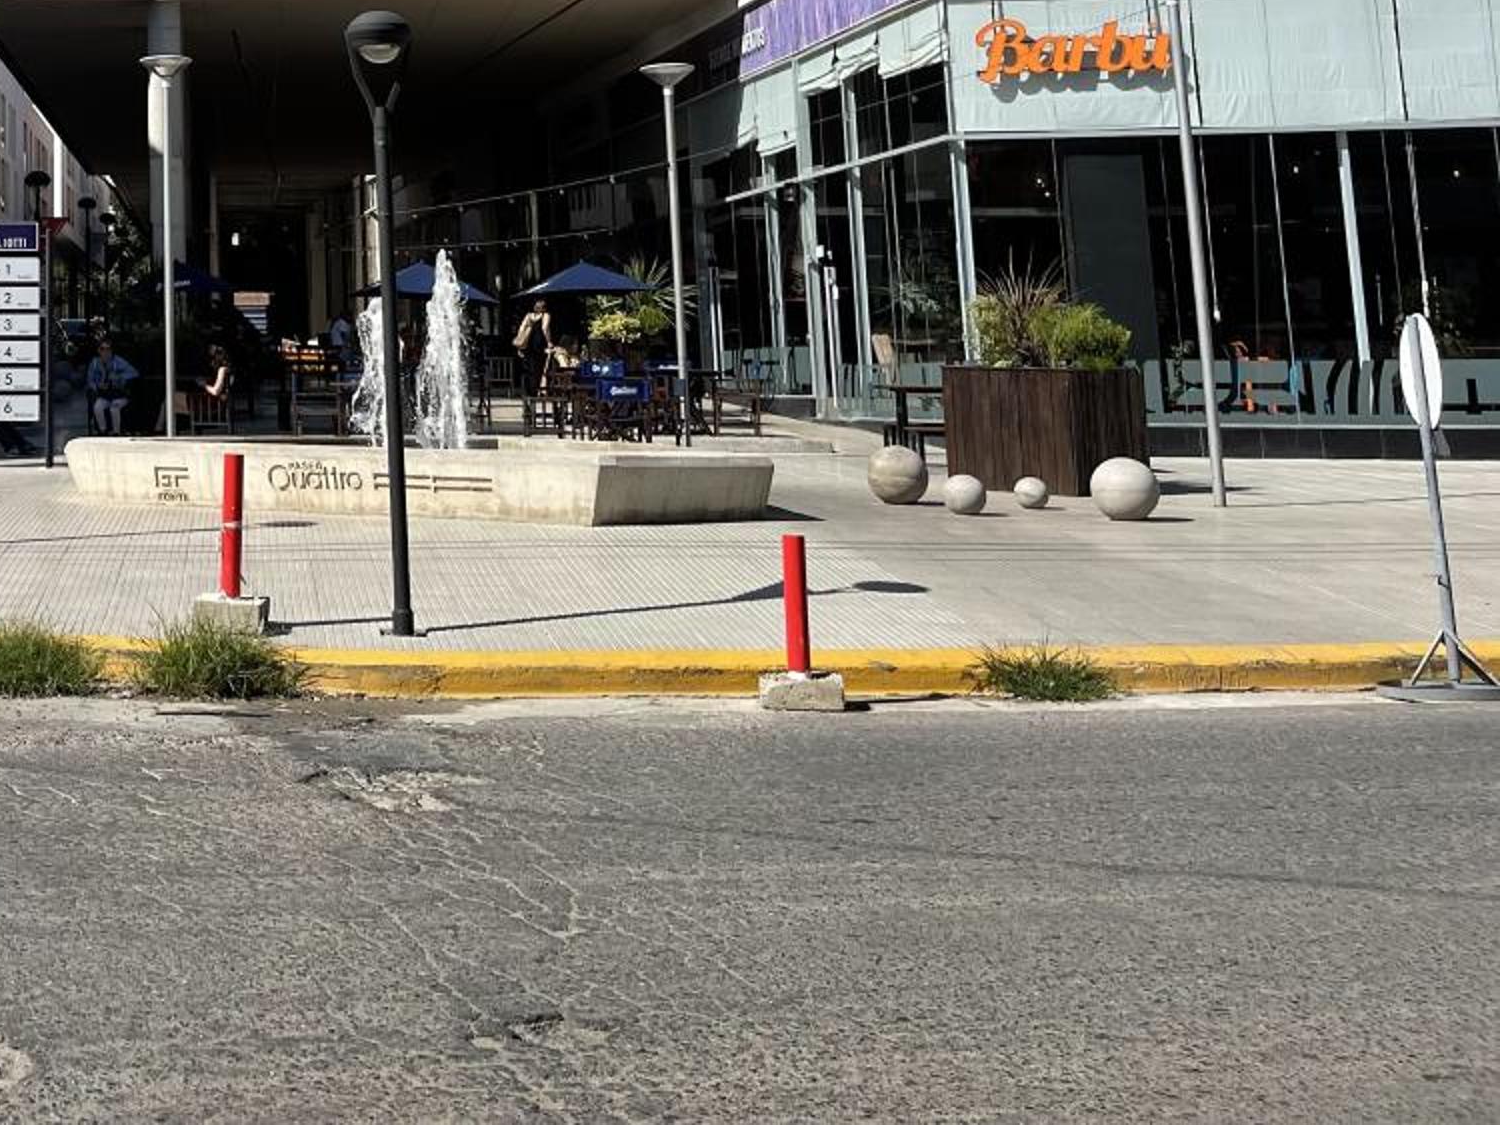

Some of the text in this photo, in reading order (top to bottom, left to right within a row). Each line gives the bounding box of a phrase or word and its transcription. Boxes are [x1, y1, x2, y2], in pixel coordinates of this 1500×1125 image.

[975, 18, 1172, 84] Barbu
[4, 292, 12, 304] 2
[4, 319, 12, 331] 3
[4, 346, 12, 358] 4
[5, 374, 13, 386] 5
[4, 402, 12, 414] 6
[268, 464, 363, 491] Quattro
